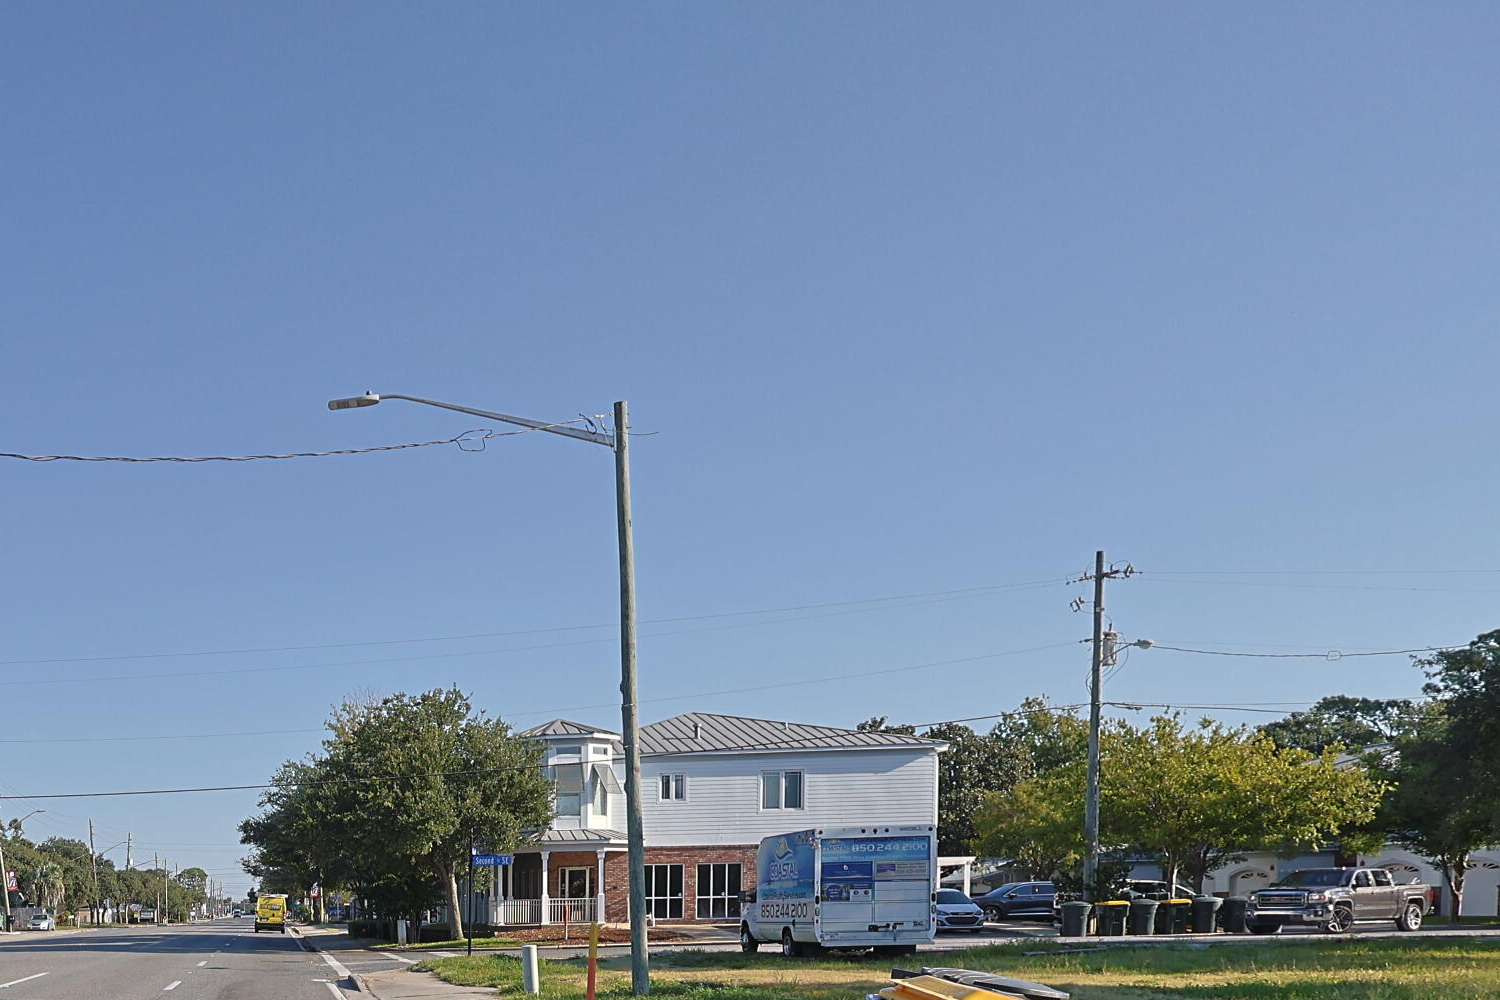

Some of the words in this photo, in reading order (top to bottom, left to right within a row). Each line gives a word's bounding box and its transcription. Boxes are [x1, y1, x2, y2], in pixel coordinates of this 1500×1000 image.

[475, 856, 495, 865] Second
[501, 856, 509, 865] SE
[770, 861, 799, 881] COASTAL
